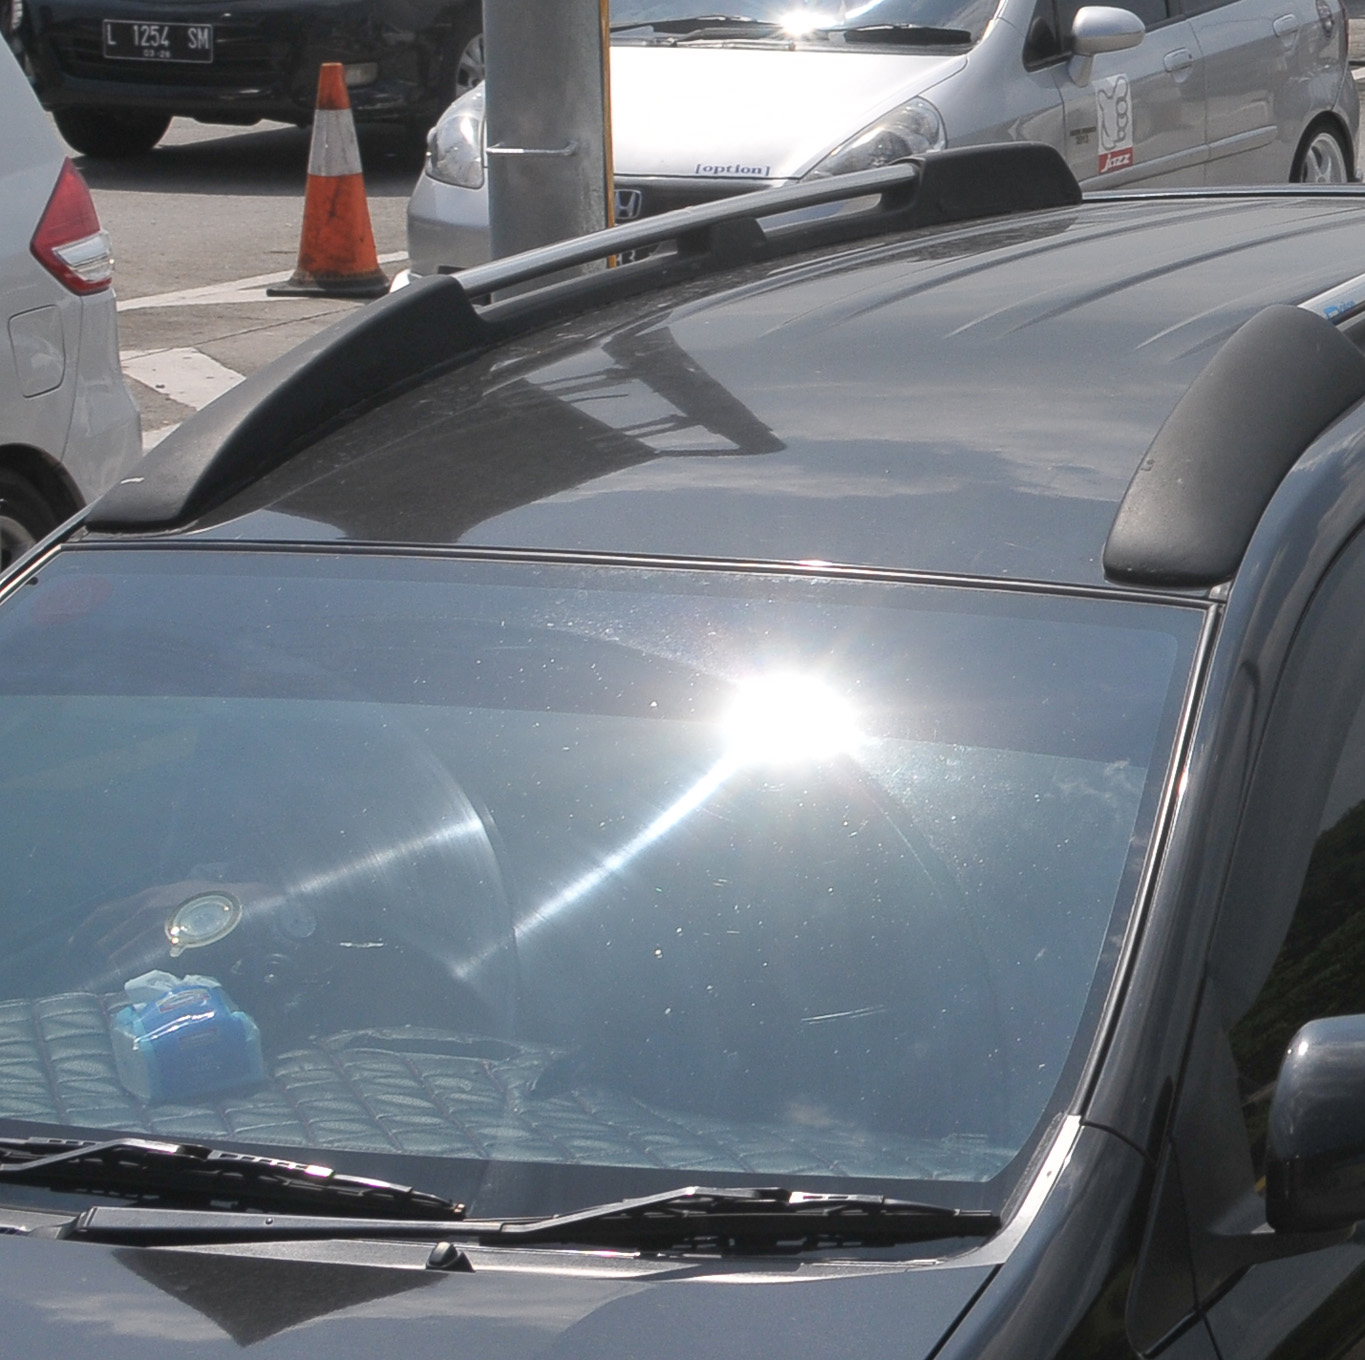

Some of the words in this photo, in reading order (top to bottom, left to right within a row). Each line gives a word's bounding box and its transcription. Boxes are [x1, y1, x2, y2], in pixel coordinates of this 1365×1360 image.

[107, 24, 117, 45] L
[133, 25, 169, 47] 1254
[188, 27, 209, 49] SM
